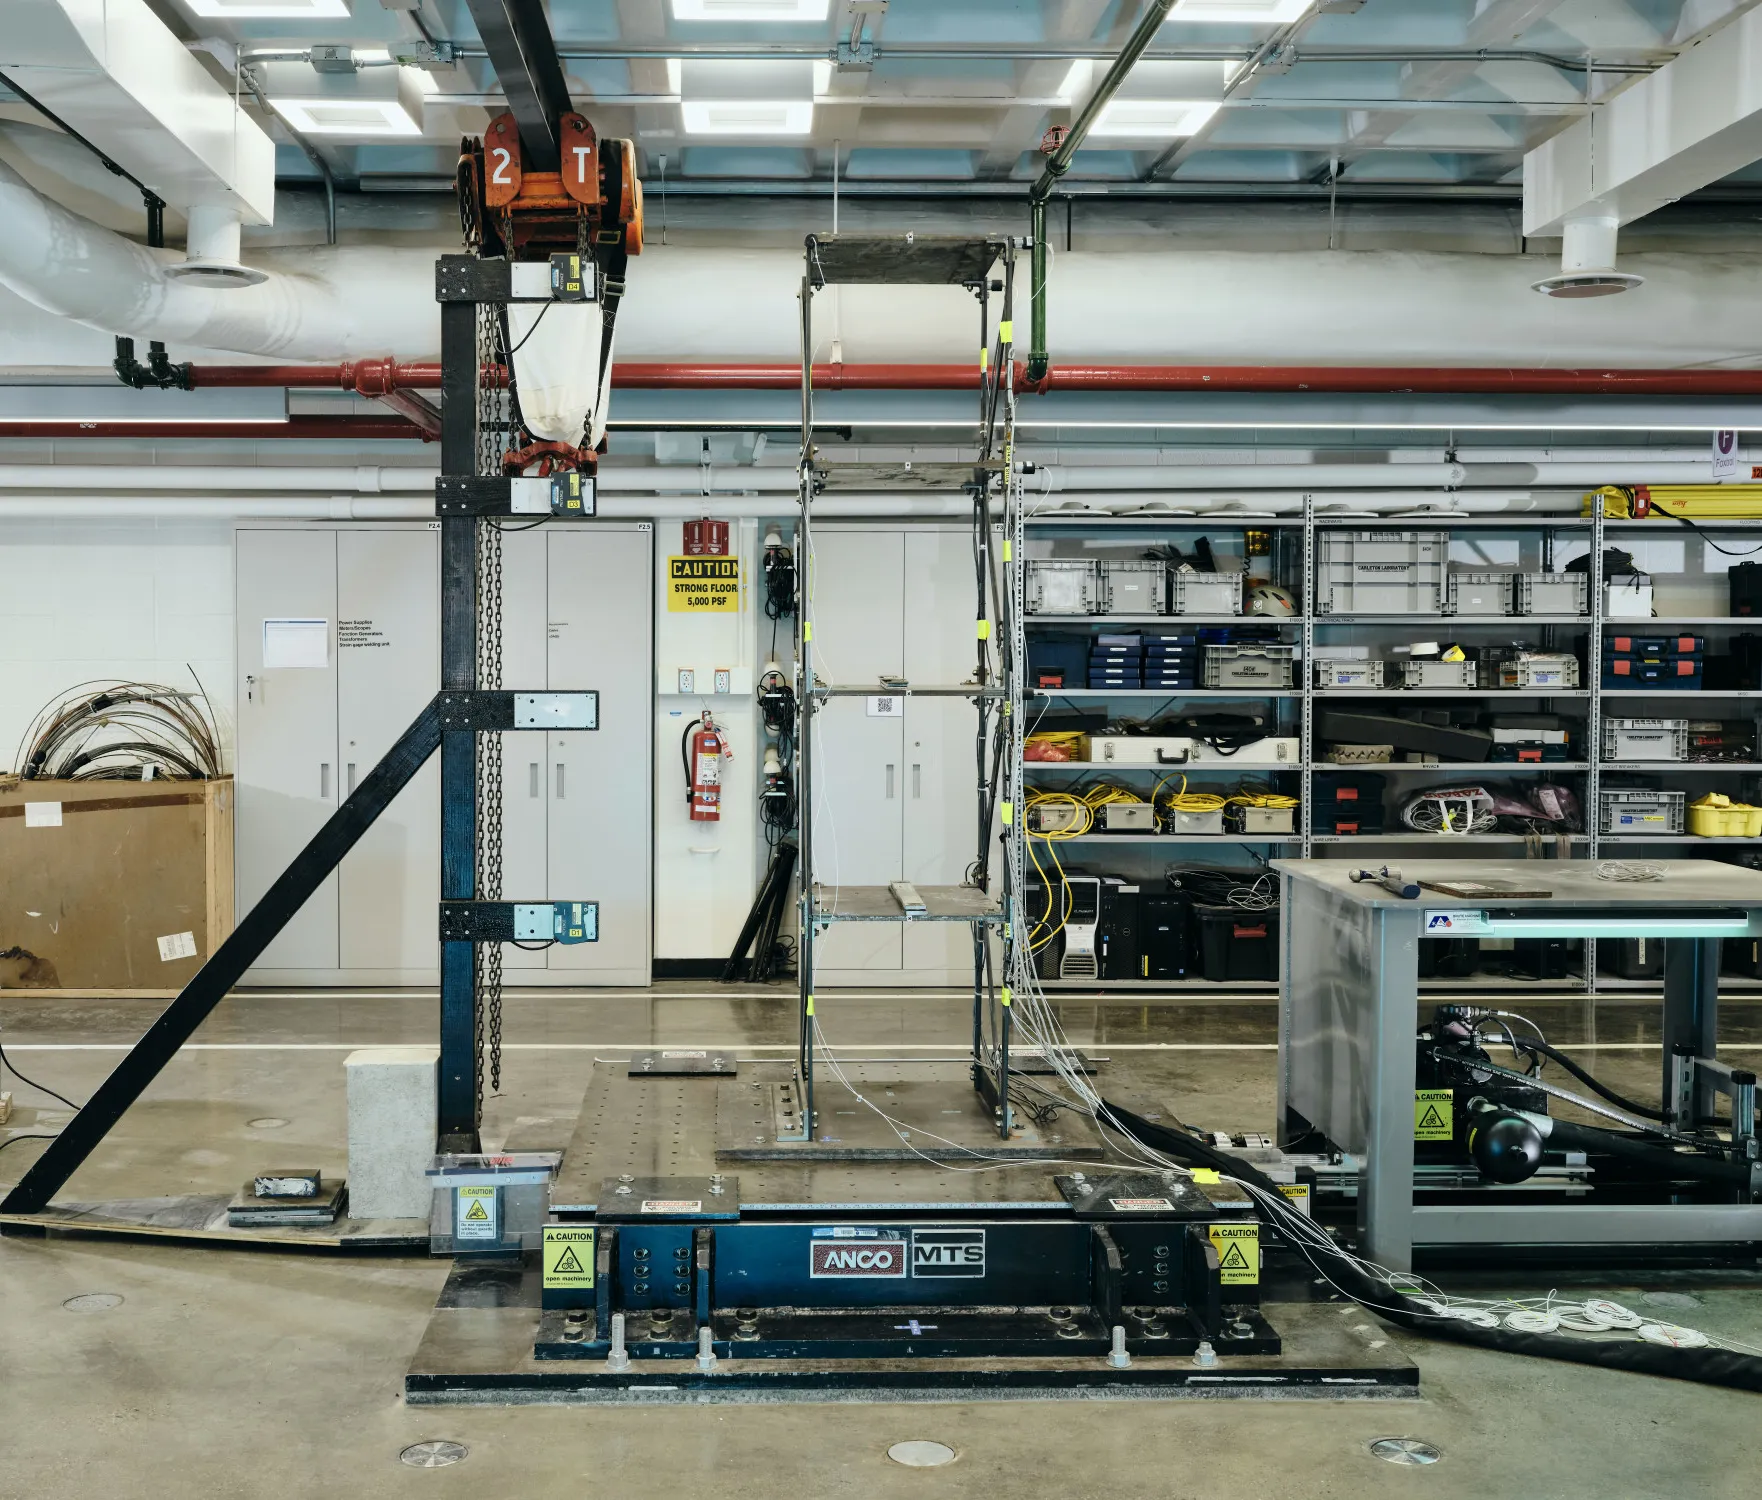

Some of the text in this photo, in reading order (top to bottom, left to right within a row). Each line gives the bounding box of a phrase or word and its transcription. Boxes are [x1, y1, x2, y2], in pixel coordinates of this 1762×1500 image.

[492, 147, 591, 184] 2 T
[674, 584, 738, 592] STRONG FLOOR
[687, 597, 727, 607] 5,000 PSF
[556, 1232, 593, 1241] CAUTION
[1221, 1229, 1258, 1237] CAUTION
[823, 1250, 893, 1269] ANCO
[914, 1246, 984, 1263] MTS
